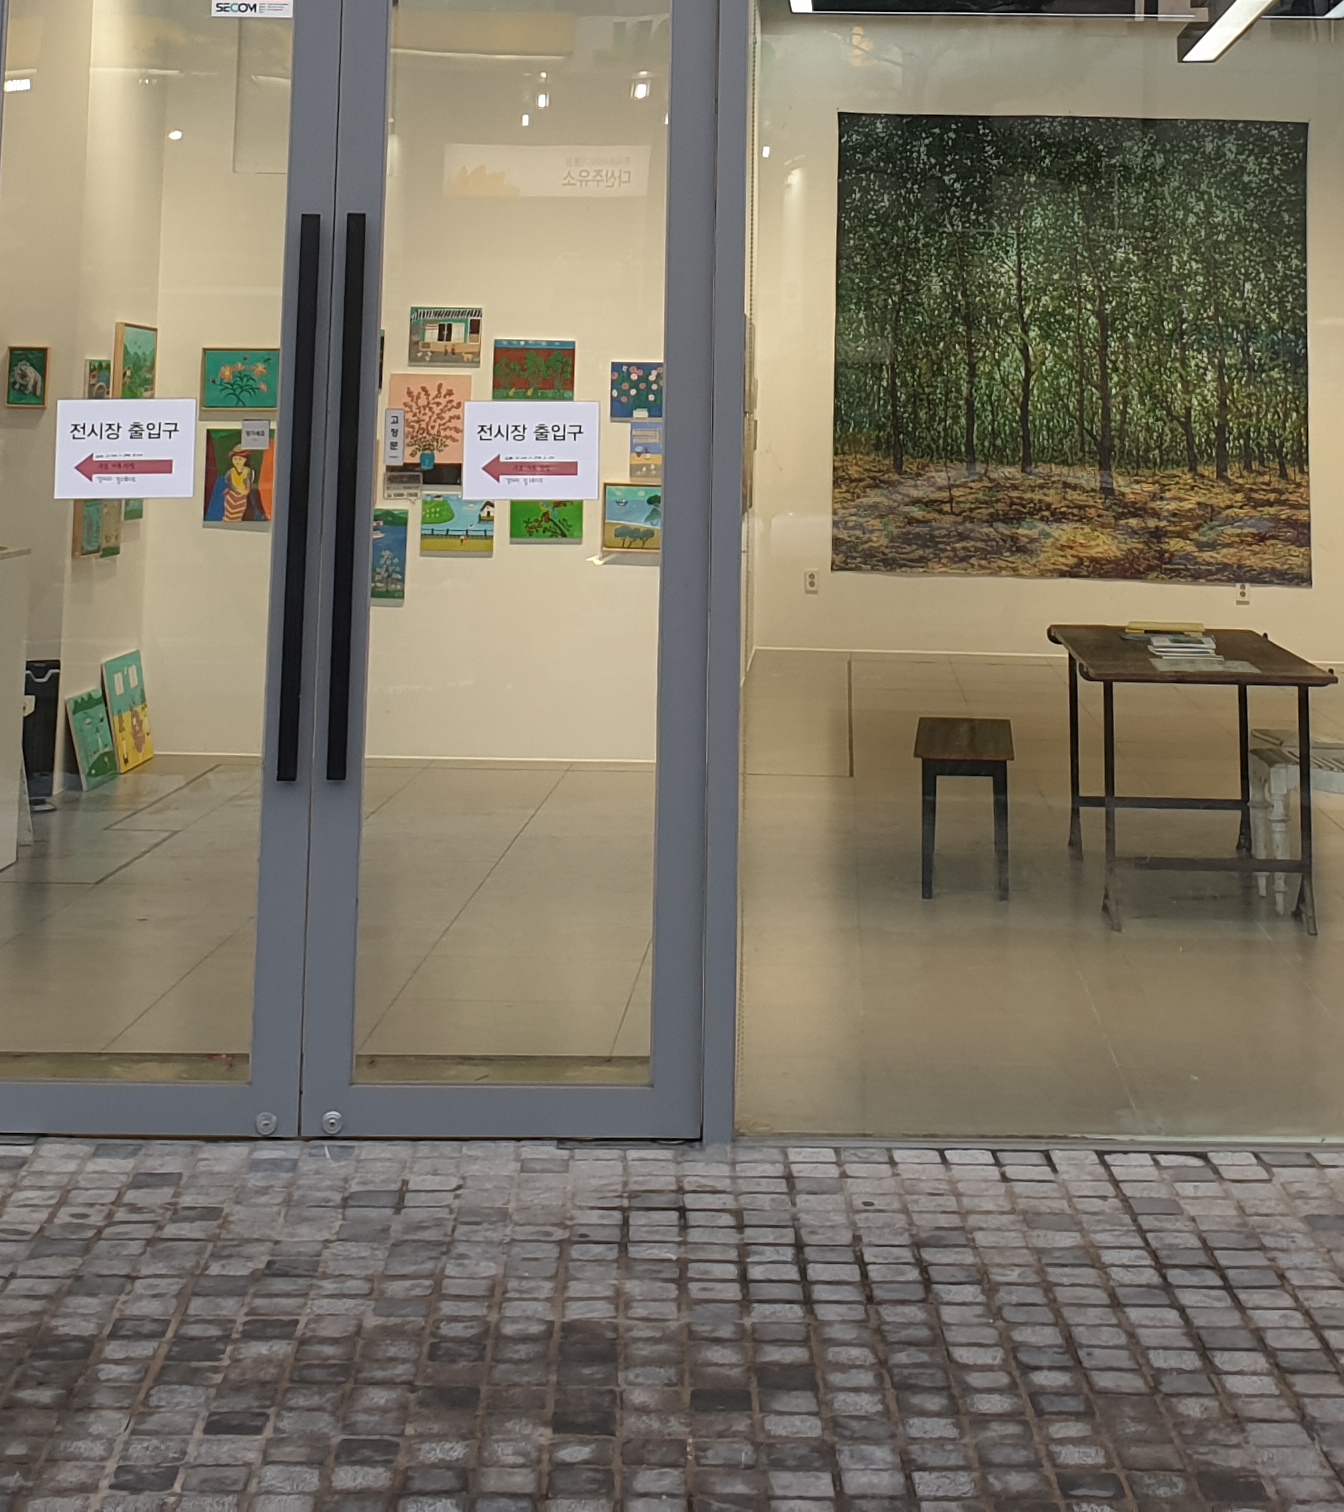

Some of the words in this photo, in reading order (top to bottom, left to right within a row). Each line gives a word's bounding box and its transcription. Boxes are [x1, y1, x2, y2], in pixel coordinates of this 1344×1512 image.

[216, 2, 257, 13] SECOM
[69, 421, 122, 440] 전시장
[127, 421, 180, 440] 출입구
[476, 423, 528, 442] 전시장
[533, 423, 584, 442] 출입구
